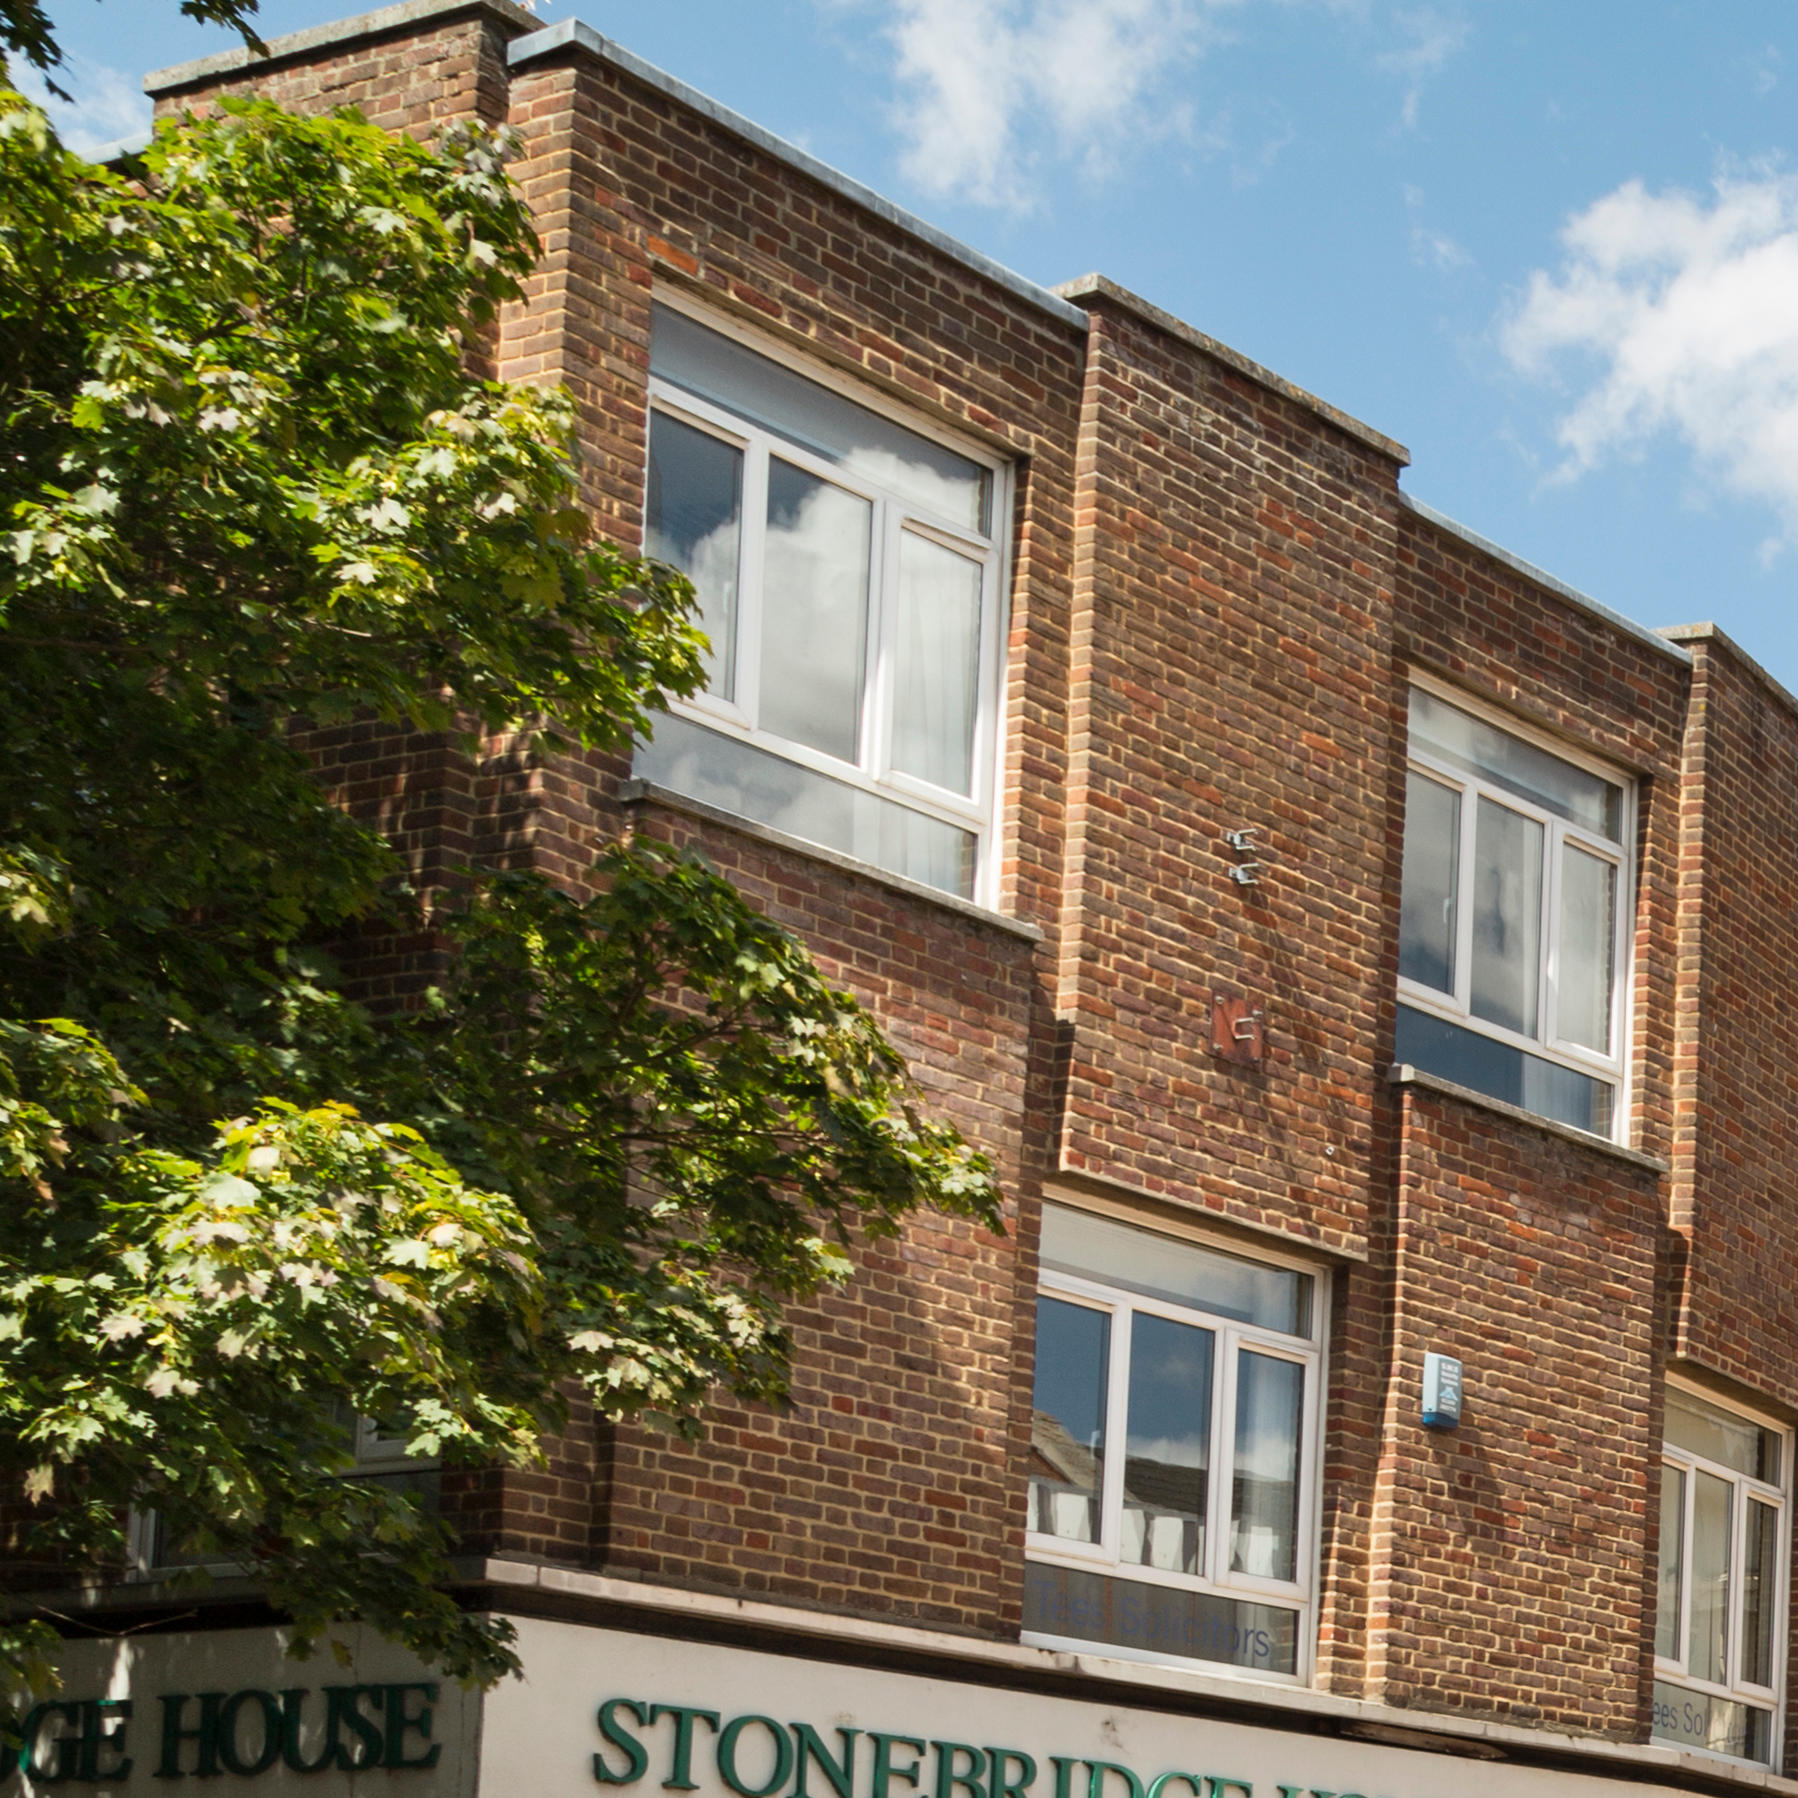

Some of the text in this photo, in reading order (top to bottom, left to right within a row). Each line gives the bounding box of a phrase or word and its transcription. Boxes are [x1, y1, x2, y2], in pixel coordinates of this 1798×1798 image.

[1033, 1580, 1270, 1658] Tees Solicitors
[153, 1682, 442, 1778] HOUSE
